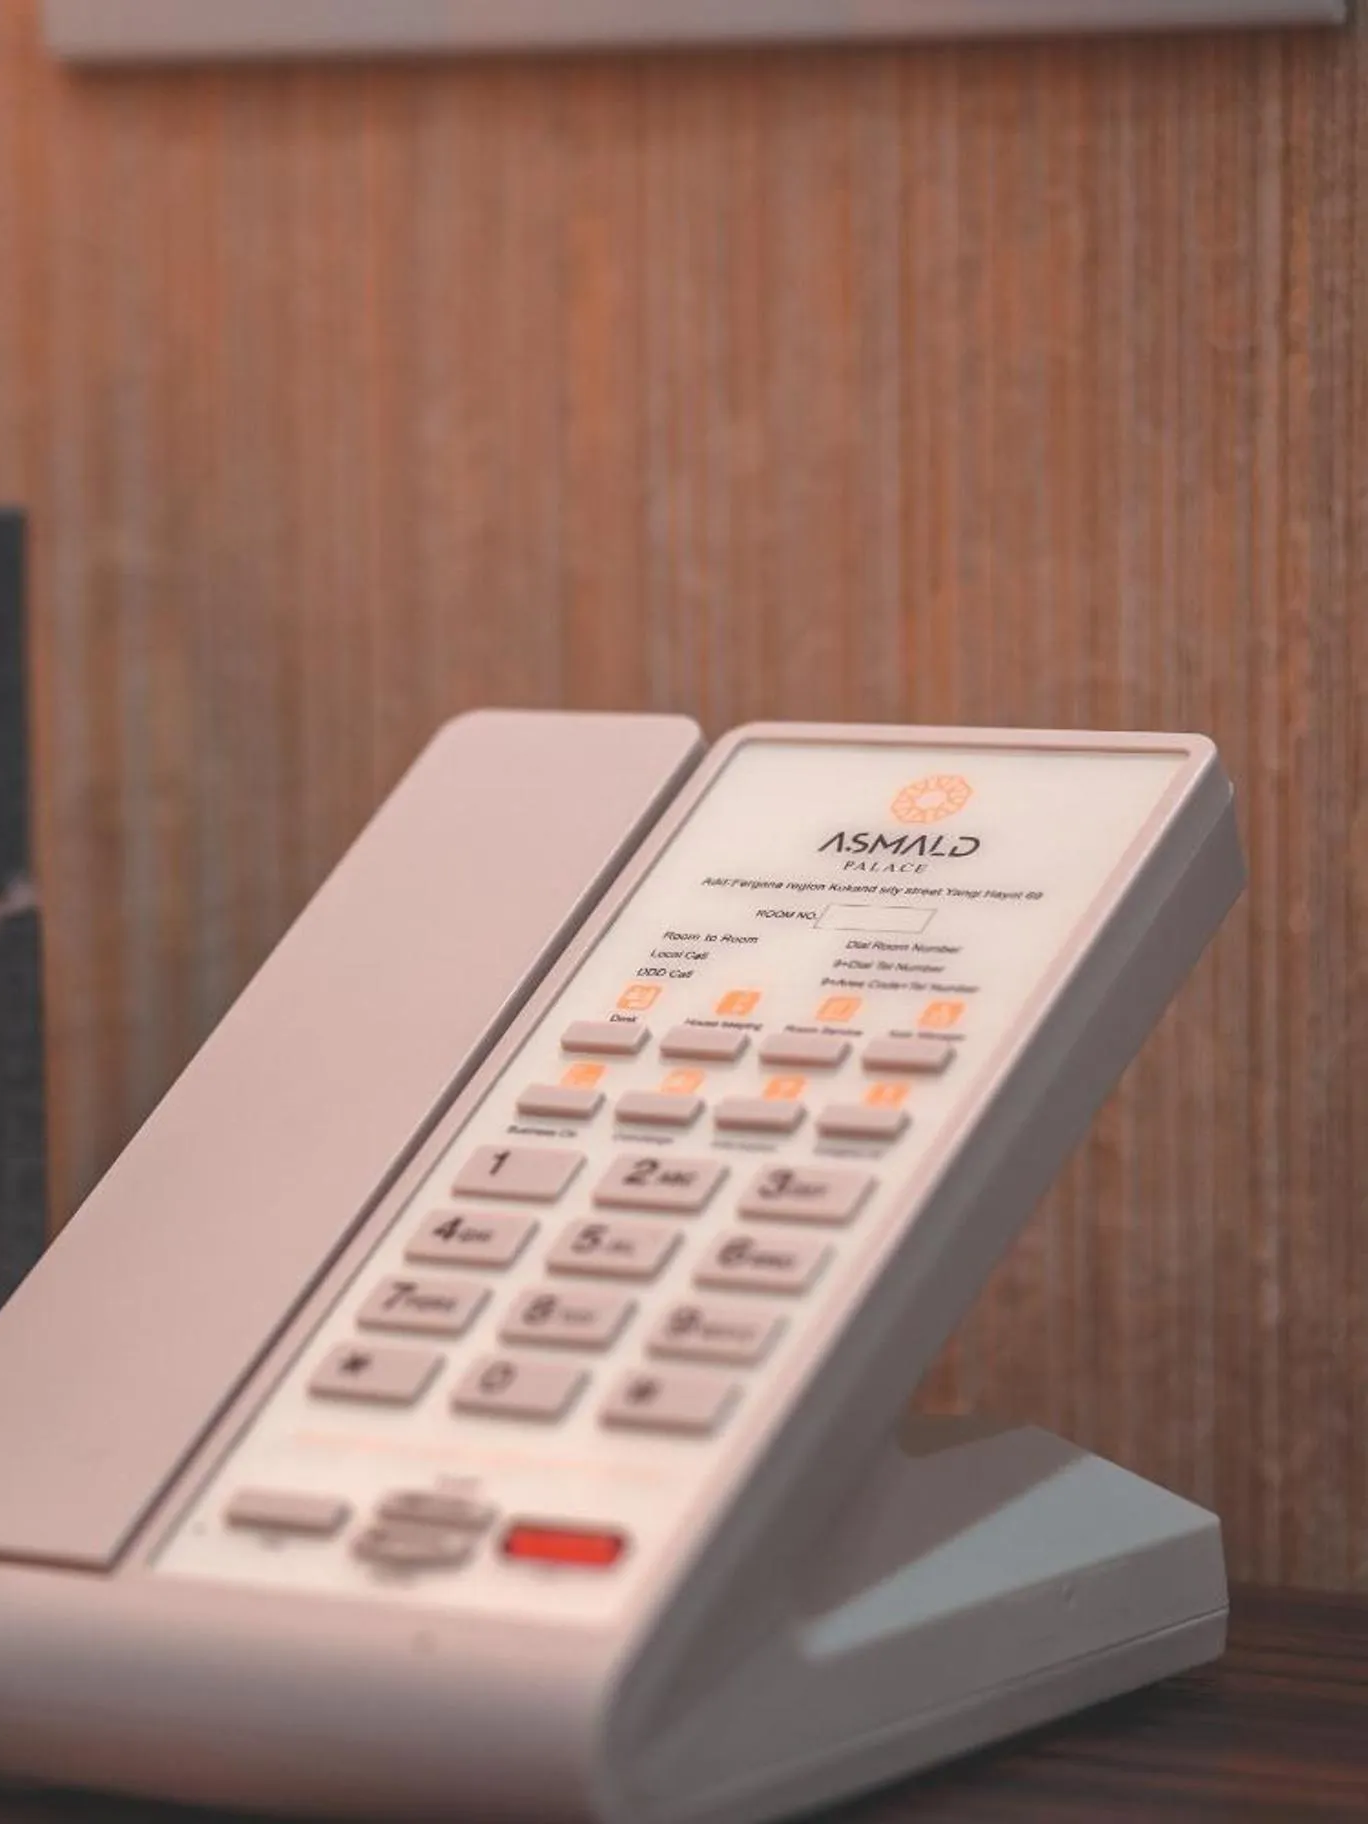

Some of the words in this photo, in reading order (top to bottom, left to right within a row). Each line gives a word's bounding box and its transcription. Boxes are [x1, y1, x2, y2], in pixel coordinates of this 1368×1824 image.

[818, 831, 980, 857] ASMALD
[843, 860, 928, 873] PALACE
[755, 908, 795, 919] ROOM
[663, 931, 701, 942] Room
[704, 932, 718, 943] to
[720, 933, 759, 944] Room
[650, 948, 683, 960] Local
[684, 950, 710, 961] Call
[669, 969, 694, 979] Call
[489, 1149, 512, 1176] 1
[621, 1157, 661, 1186] 2
[757, 1168, 796, 1200] 3
[432, 1216, 464, 1242] 4
[570, 1223, 609, 1255] 5
[716, 1233, 756, 1269] 6
[382, 1281, 419, 1310] 7
[477, 1360, 518, 1395] 0
